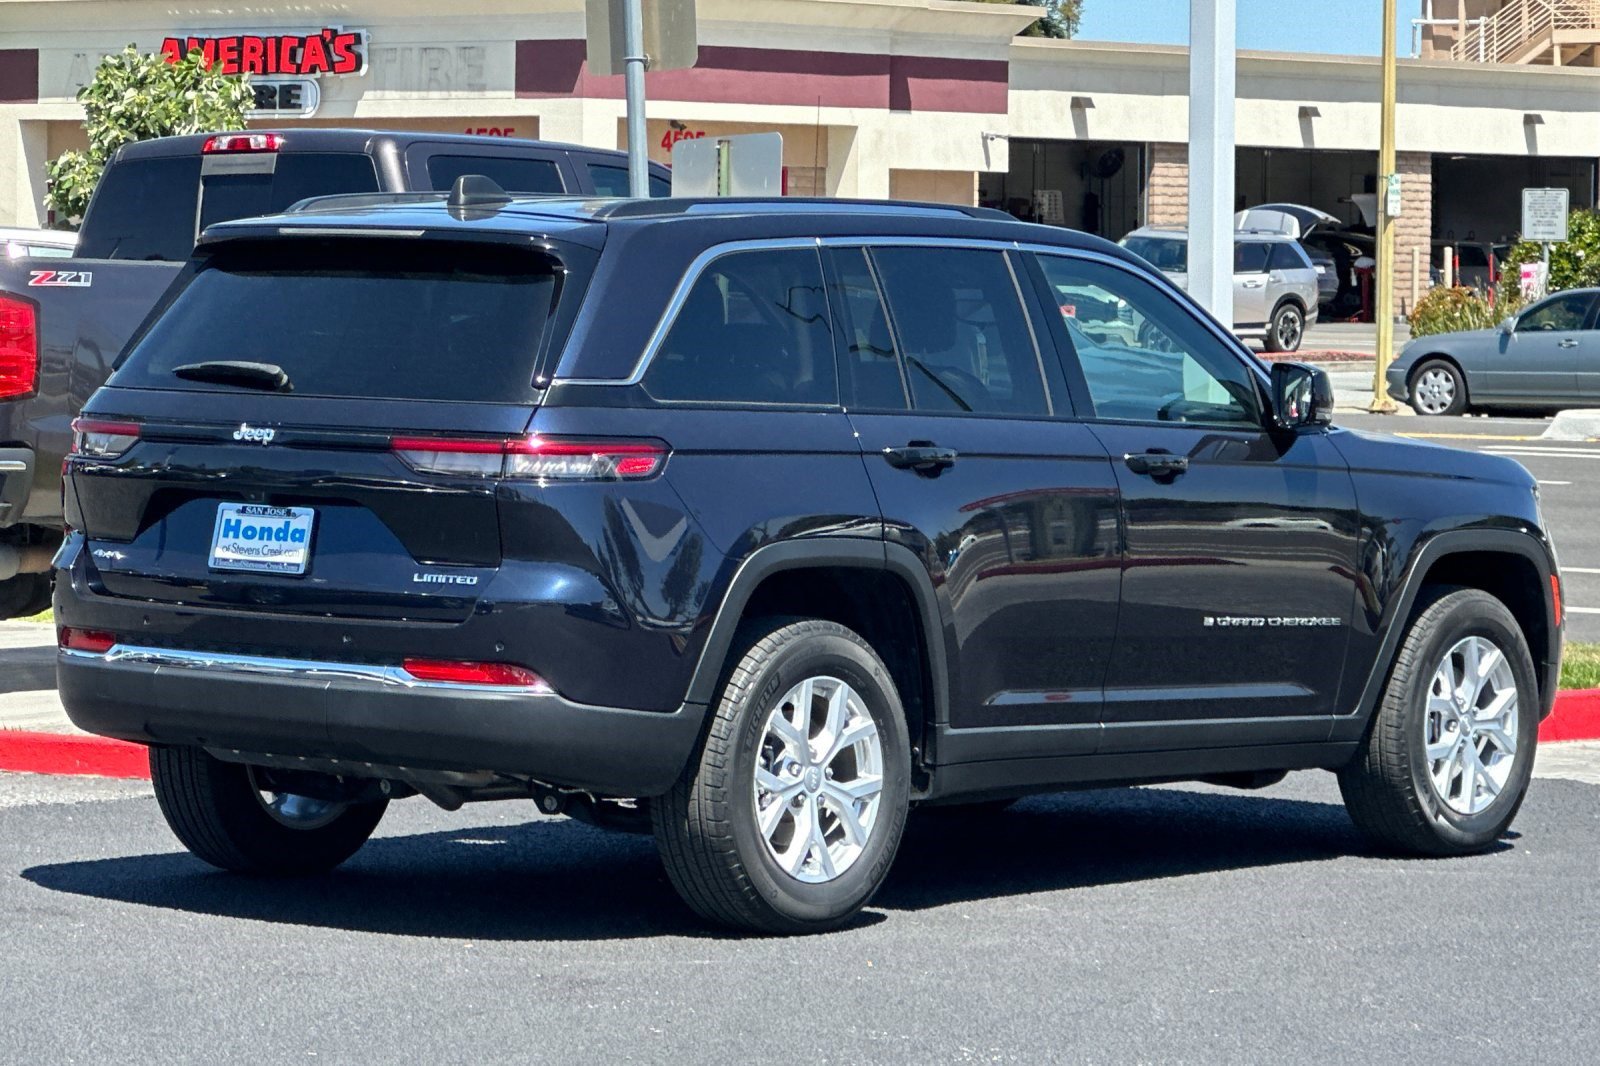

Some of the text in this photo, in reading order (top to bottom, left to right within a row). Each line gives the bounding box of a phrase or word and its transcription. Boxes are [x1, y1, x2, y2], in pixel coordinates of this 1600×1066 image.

[160, 28, 361, 75] AMERICA'S
[252, 84, 302, 110] RE
[28, 270, 93, 287] Z71
[232, 422, 276, 446] Jeep
[245, 505, 288, 516] SAN JOSE
[222, 518, 306, 543] Honda
[221, 545, 231, 553] of
[231, 542, 261, 556] Stevens
[413, 573, 478, 585] LIMITED
[1216, 616, 1265, 627] GRAND
[1267, 616, 1342, 626] CHEROKEE
